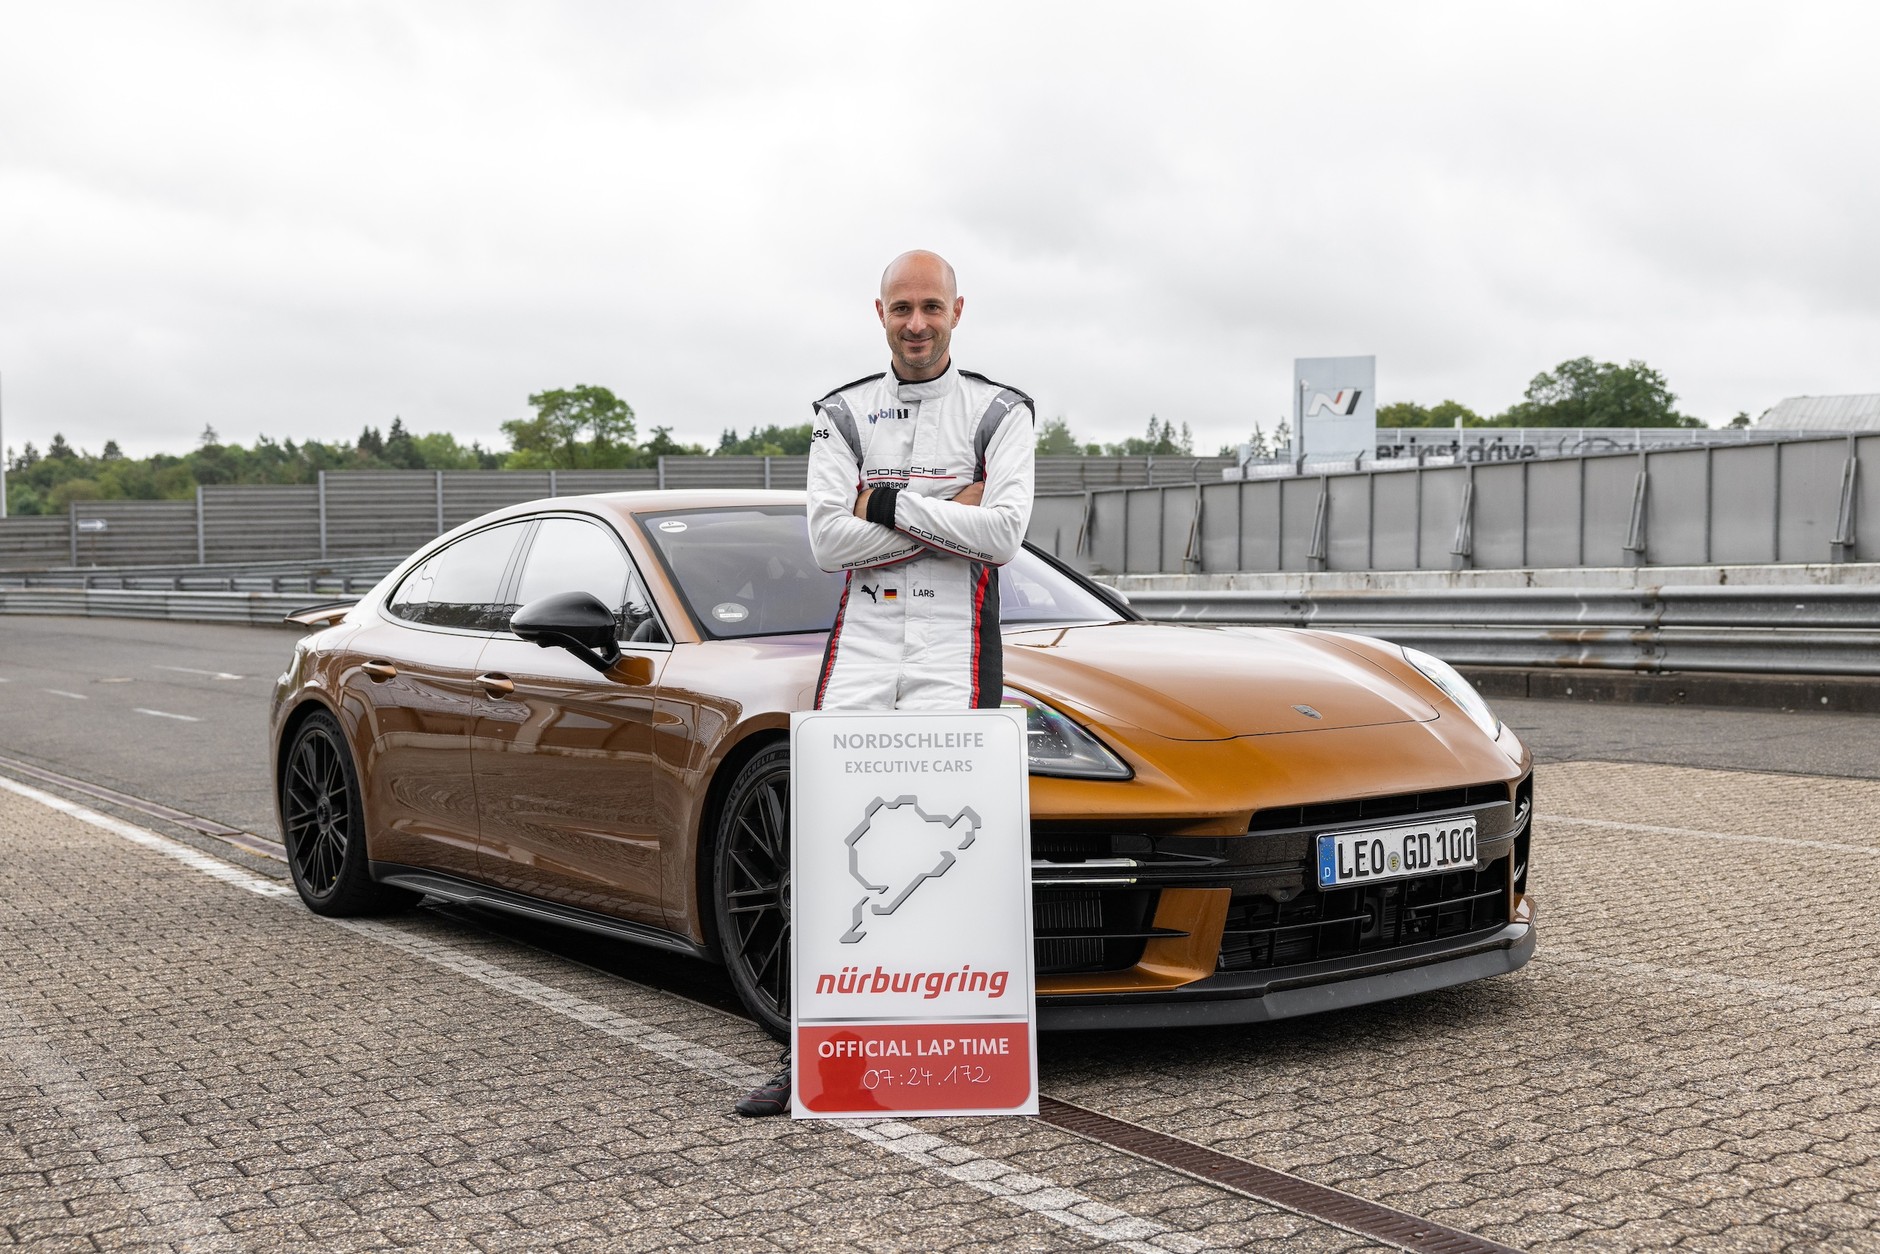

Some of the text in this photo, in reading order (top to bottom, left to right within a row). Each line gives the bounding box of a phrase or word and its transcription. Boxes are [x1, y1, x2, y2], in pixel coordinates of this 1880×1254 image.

[868, 408, 895, 425] Mbil
[1466, 437, 1537, 463] drive
[867, 466, 947, 477] PORSCHE
[908, 525, 993, 561] PORSCHE
[912, 588, 935, 598] LARS
[833, 732, 984, 749] NORDSCHLEIFE
[738, 752, 776, 788] MICHELIN
[845, 760, 973, 773] EXECUTIVE CARS
[1338, 827, 1474, 878] LEO GD 100
[1324, 867, 1331, 877] D
[815, 964, 1009, 999] nürburgring
[818, 1037, 1010, 1058] OFFICIAL LAP TIME
[862, 1064, 992, 1090] 07:24.172
